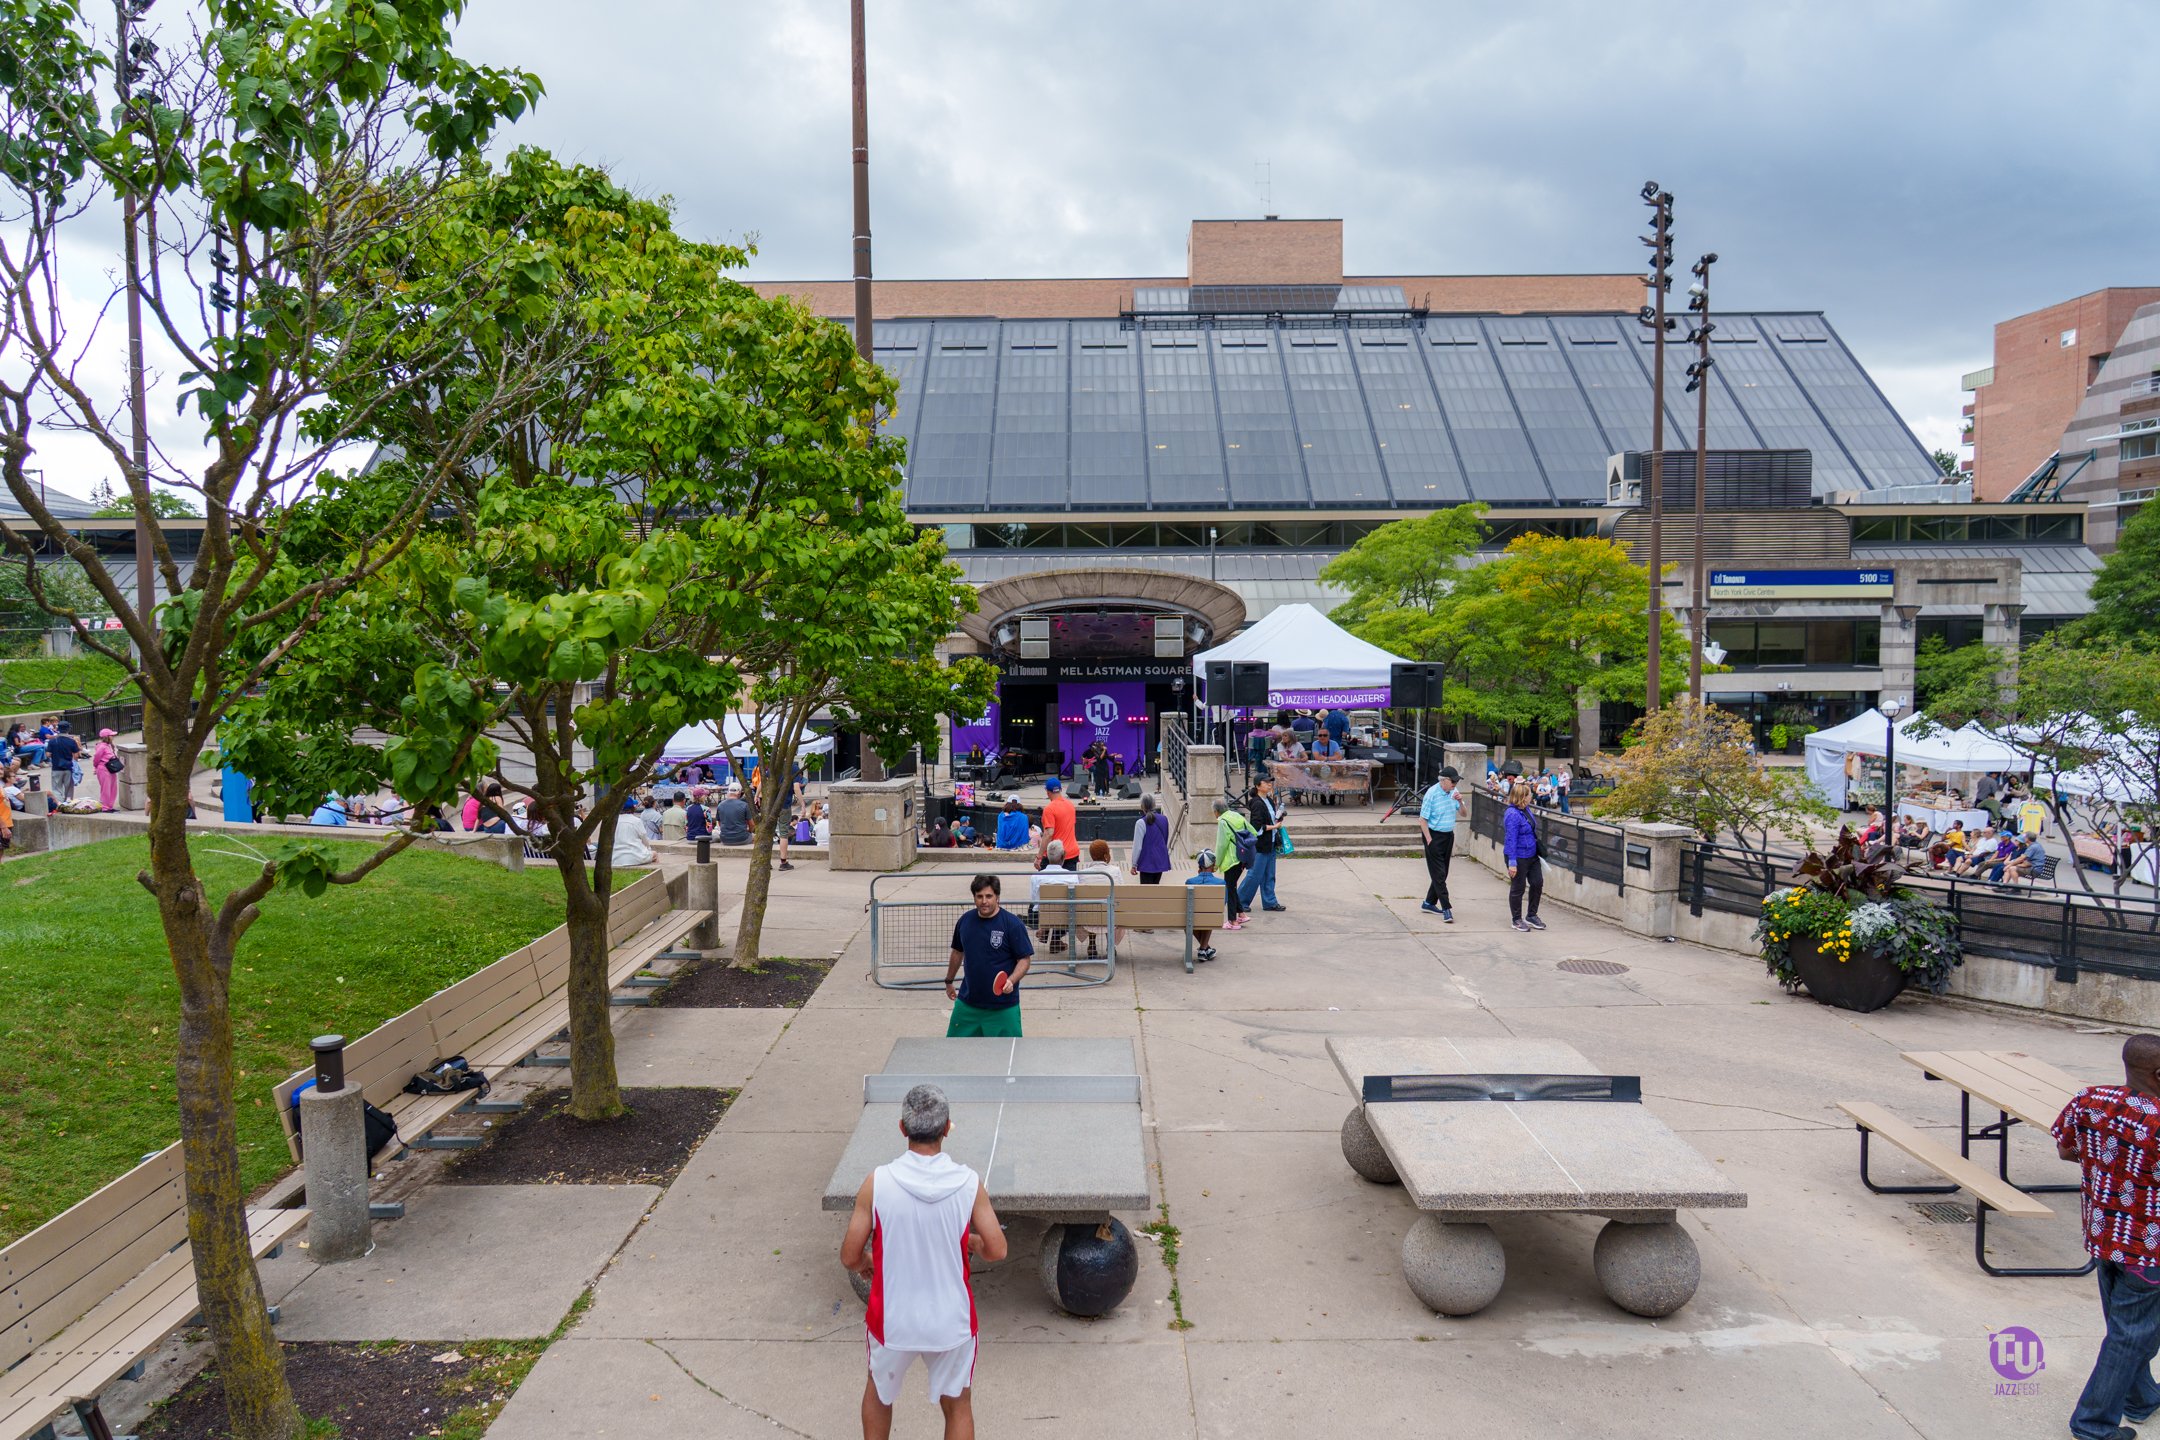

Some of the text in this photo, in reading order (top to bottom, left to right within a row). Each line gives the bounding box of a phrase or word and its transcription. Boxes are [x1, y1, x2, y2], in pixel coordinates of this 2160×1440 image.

[1859, 573, 1878, 583] 5100
[1714, 588, 1730, 596] North
[1731, 588, 1742, 596] York
[1060, 665, 1192, 676] MEL LASTMAN SQUARE
[1317, 693, 1386, 704] HEADQUARTERS
[1094, 727, 1110, 736] JAZZ
